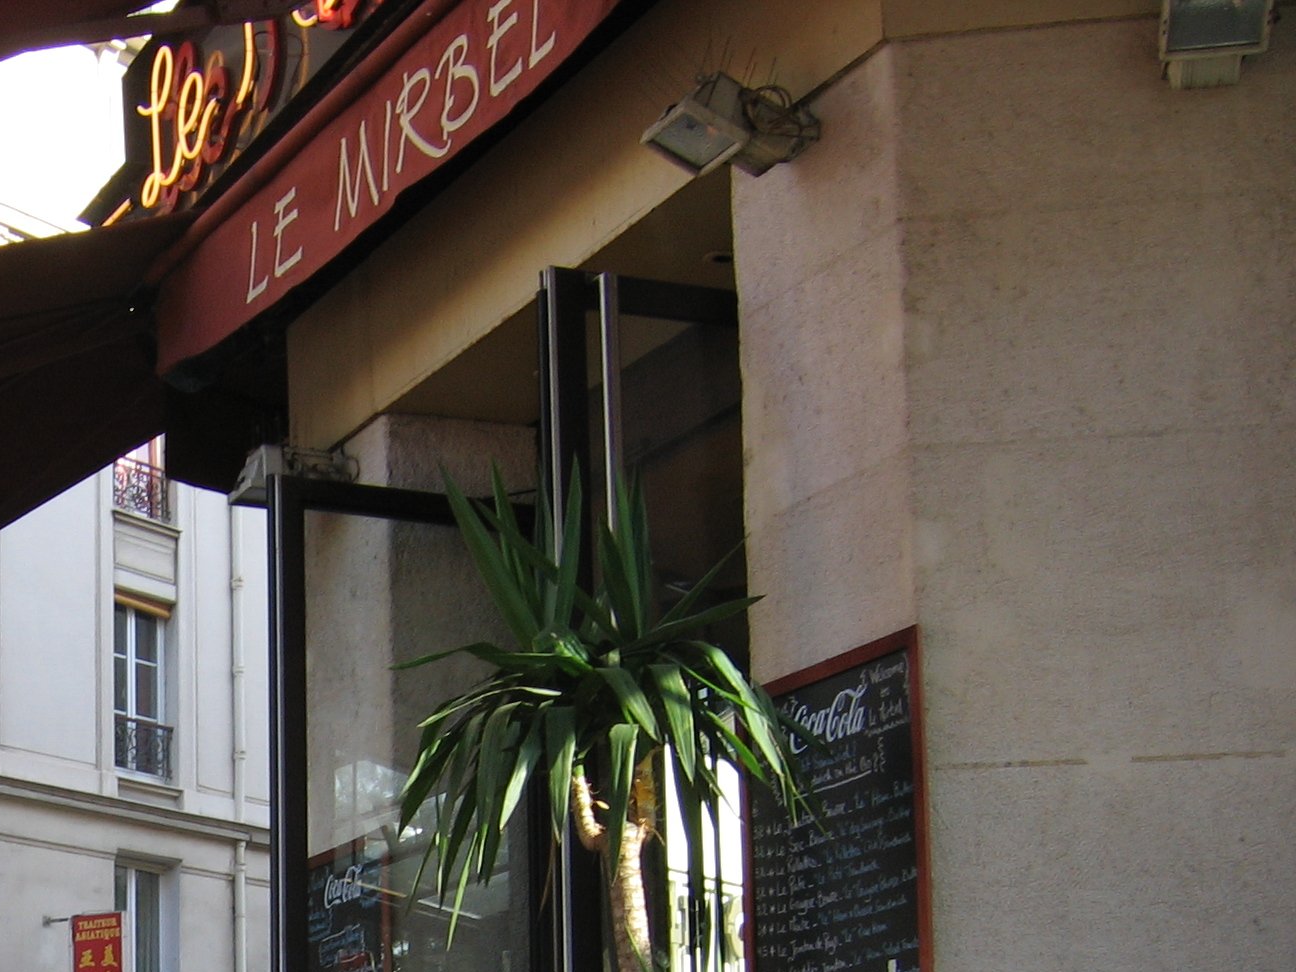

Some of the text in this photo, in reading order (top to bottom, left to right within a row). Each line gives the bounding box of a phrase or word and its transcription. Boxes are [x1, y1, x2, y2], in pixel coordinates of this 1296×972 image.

[246, 186, 303, 304] LE
[334, 0, 556, 232] MIRBEL
[75, 928, 121, 942] ASIATIQUE
